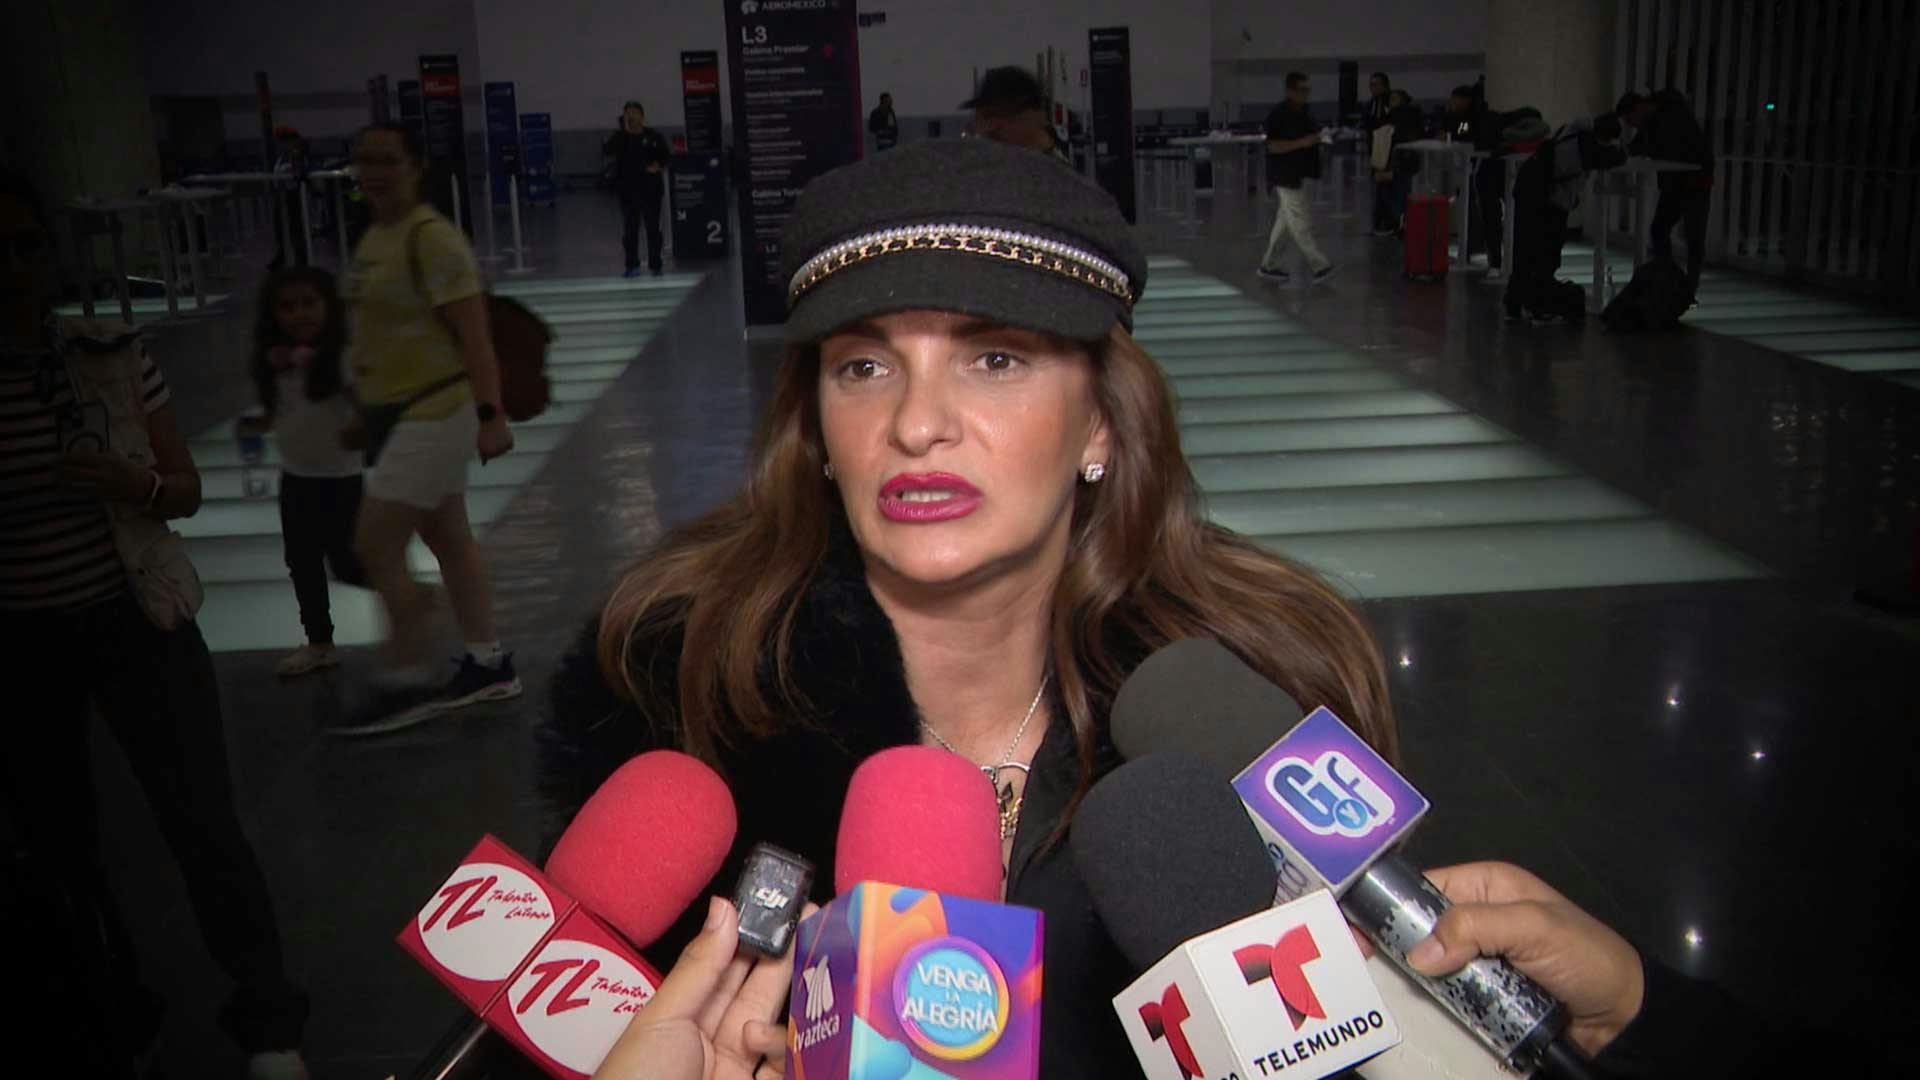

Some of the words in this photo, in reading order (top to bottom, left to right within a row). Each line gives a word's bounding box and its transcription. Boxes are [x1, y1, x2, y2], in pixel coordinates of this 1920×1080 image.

[741, 25, 768, 45] L3
[706, 219, 723, 244] 2
[422, 875, 498, 933] TL
[516, 958, 601, 1016] TL
[591, 976, 649, 1000] Talentos
[916, 961, 994, 998] VENGA
[945, 990, 962, 1006] LA
[901, 997, 1000, 1034] ALEGRÍA
[1254, 1010, 1384, 1077] TELEMUNDO
